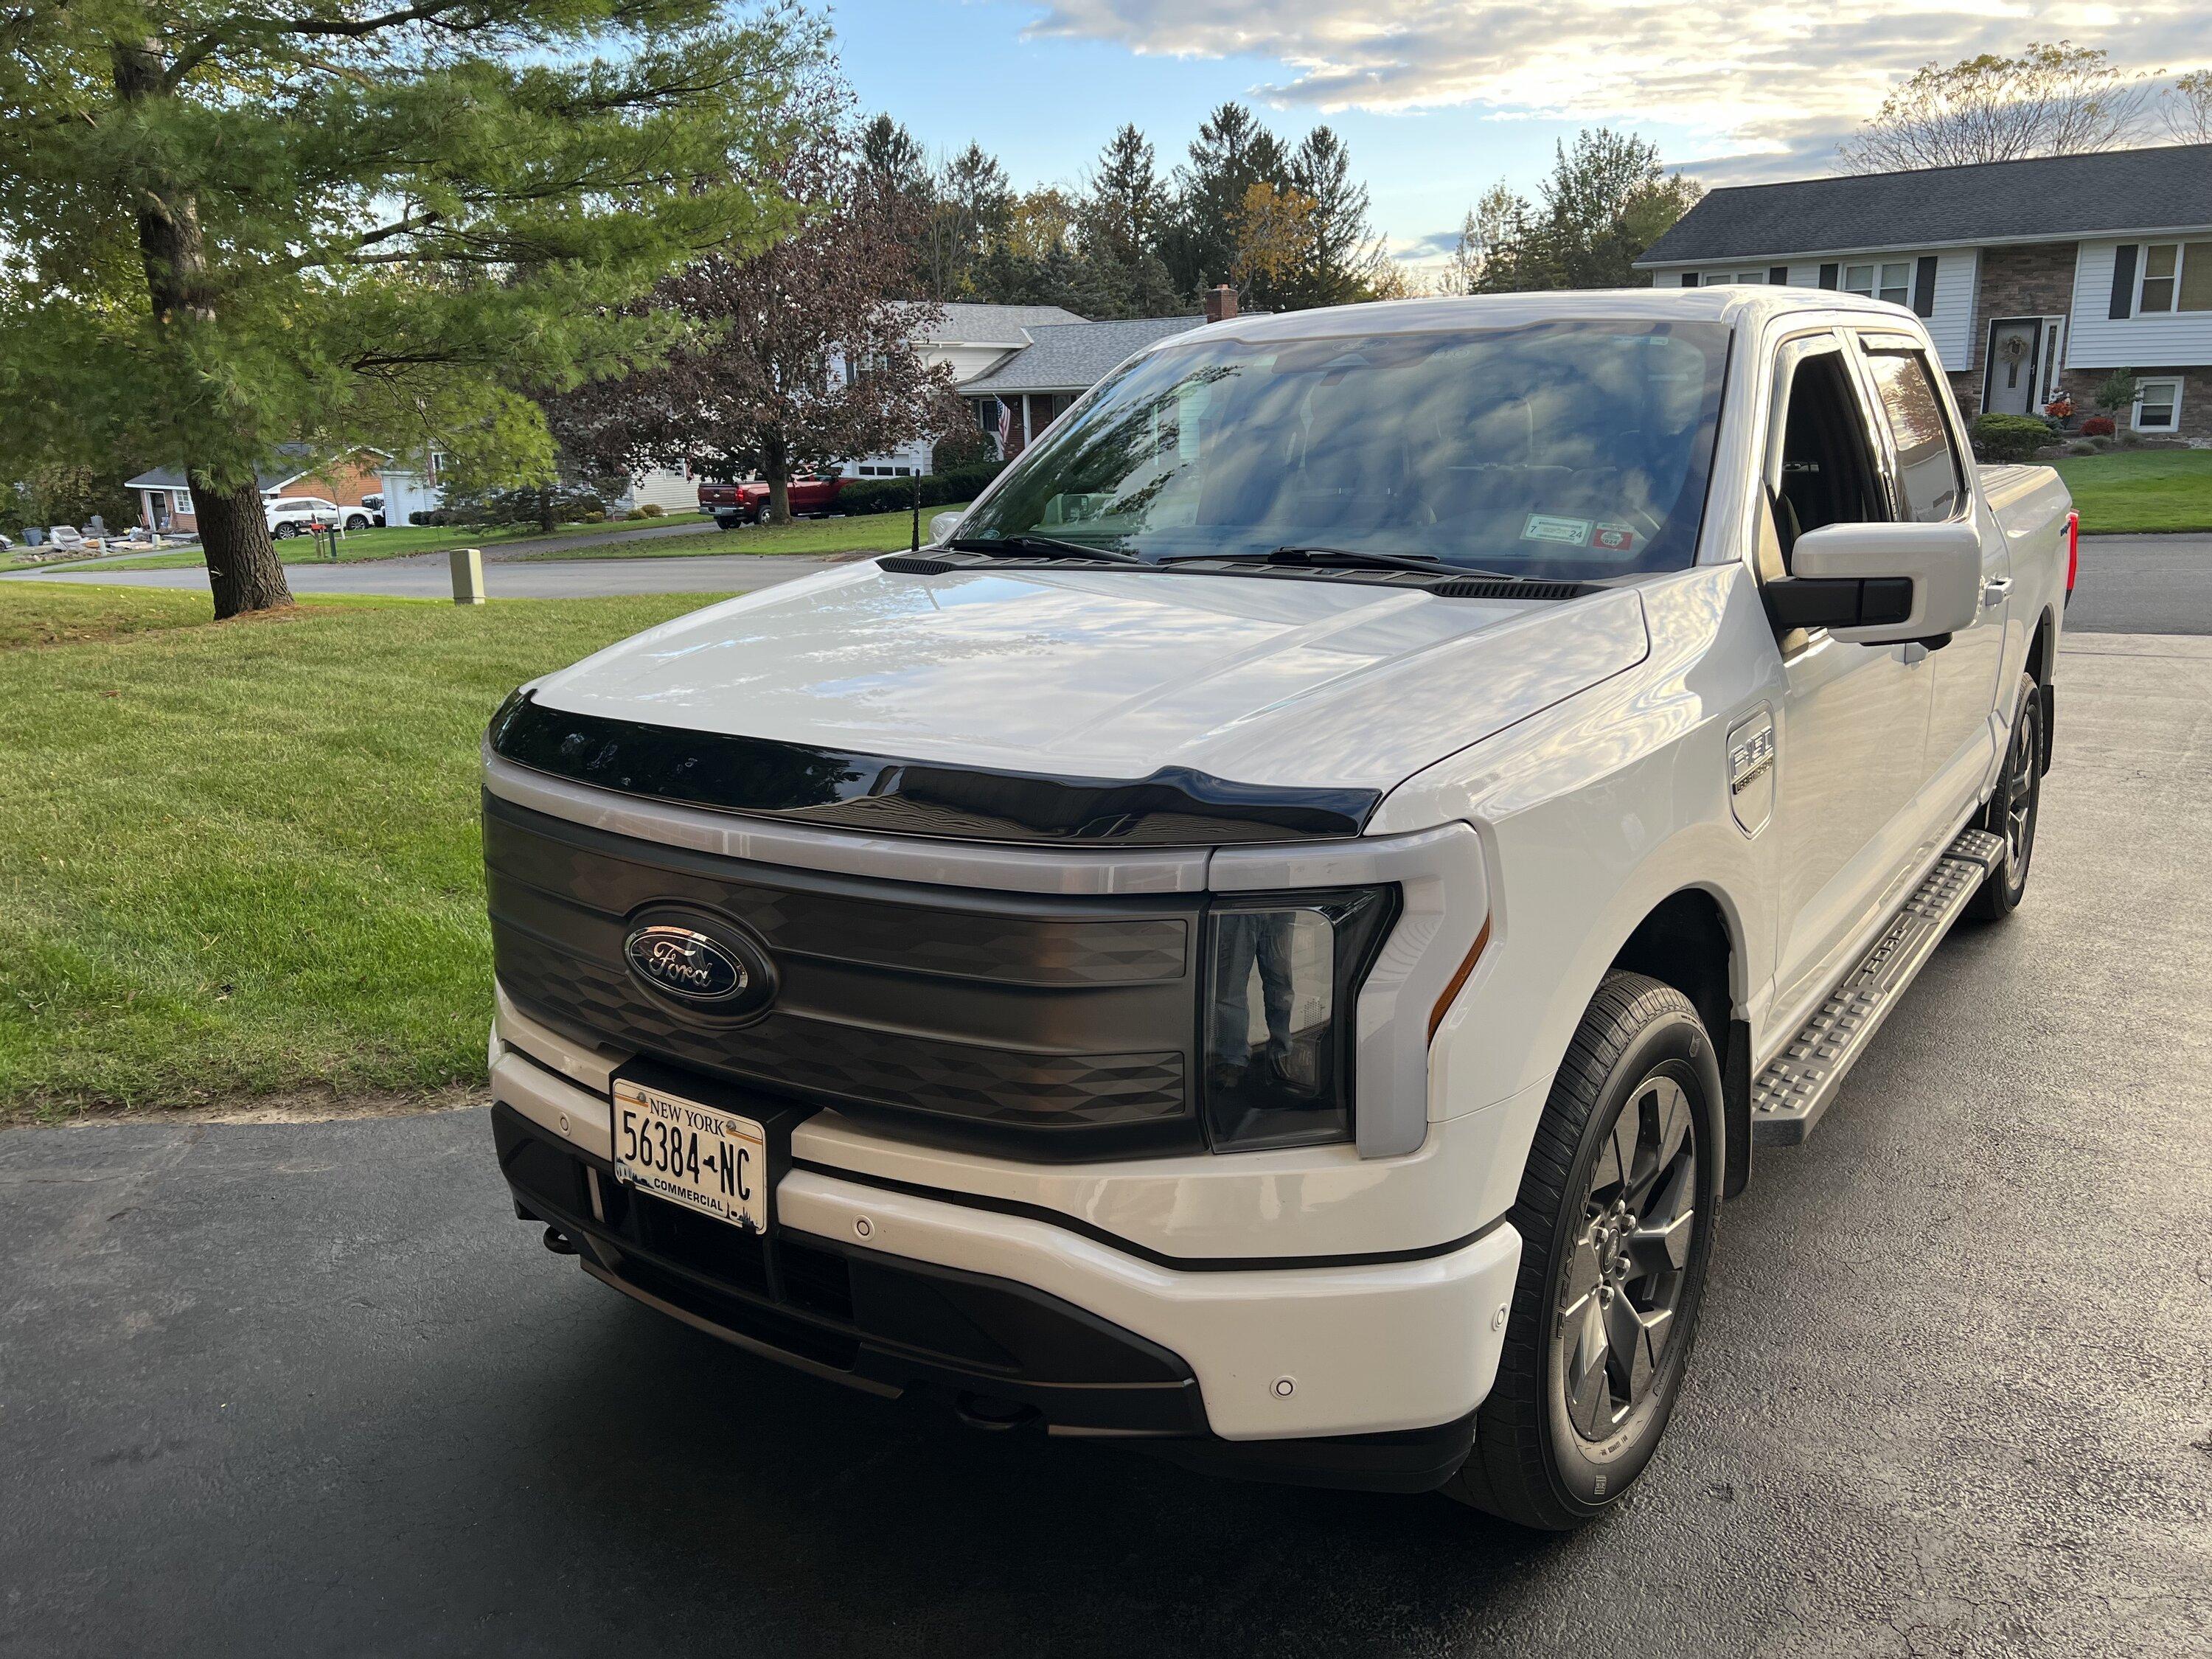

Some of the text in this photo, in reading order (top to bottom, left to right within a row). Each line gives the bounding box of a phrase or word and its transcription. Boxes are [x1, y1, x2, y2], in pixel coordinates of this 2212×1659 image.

[1568, 530, 1583, 539] 24
[648, 941, 713, 988] Ford
[1862, 928, 1907, 974] FORD
[650, 1097, 726, 1138] NEW YORK
[623, 1110, 751, 1201] 56384 NC
[654, 1178, 723, 1212] COMMERCIAL
